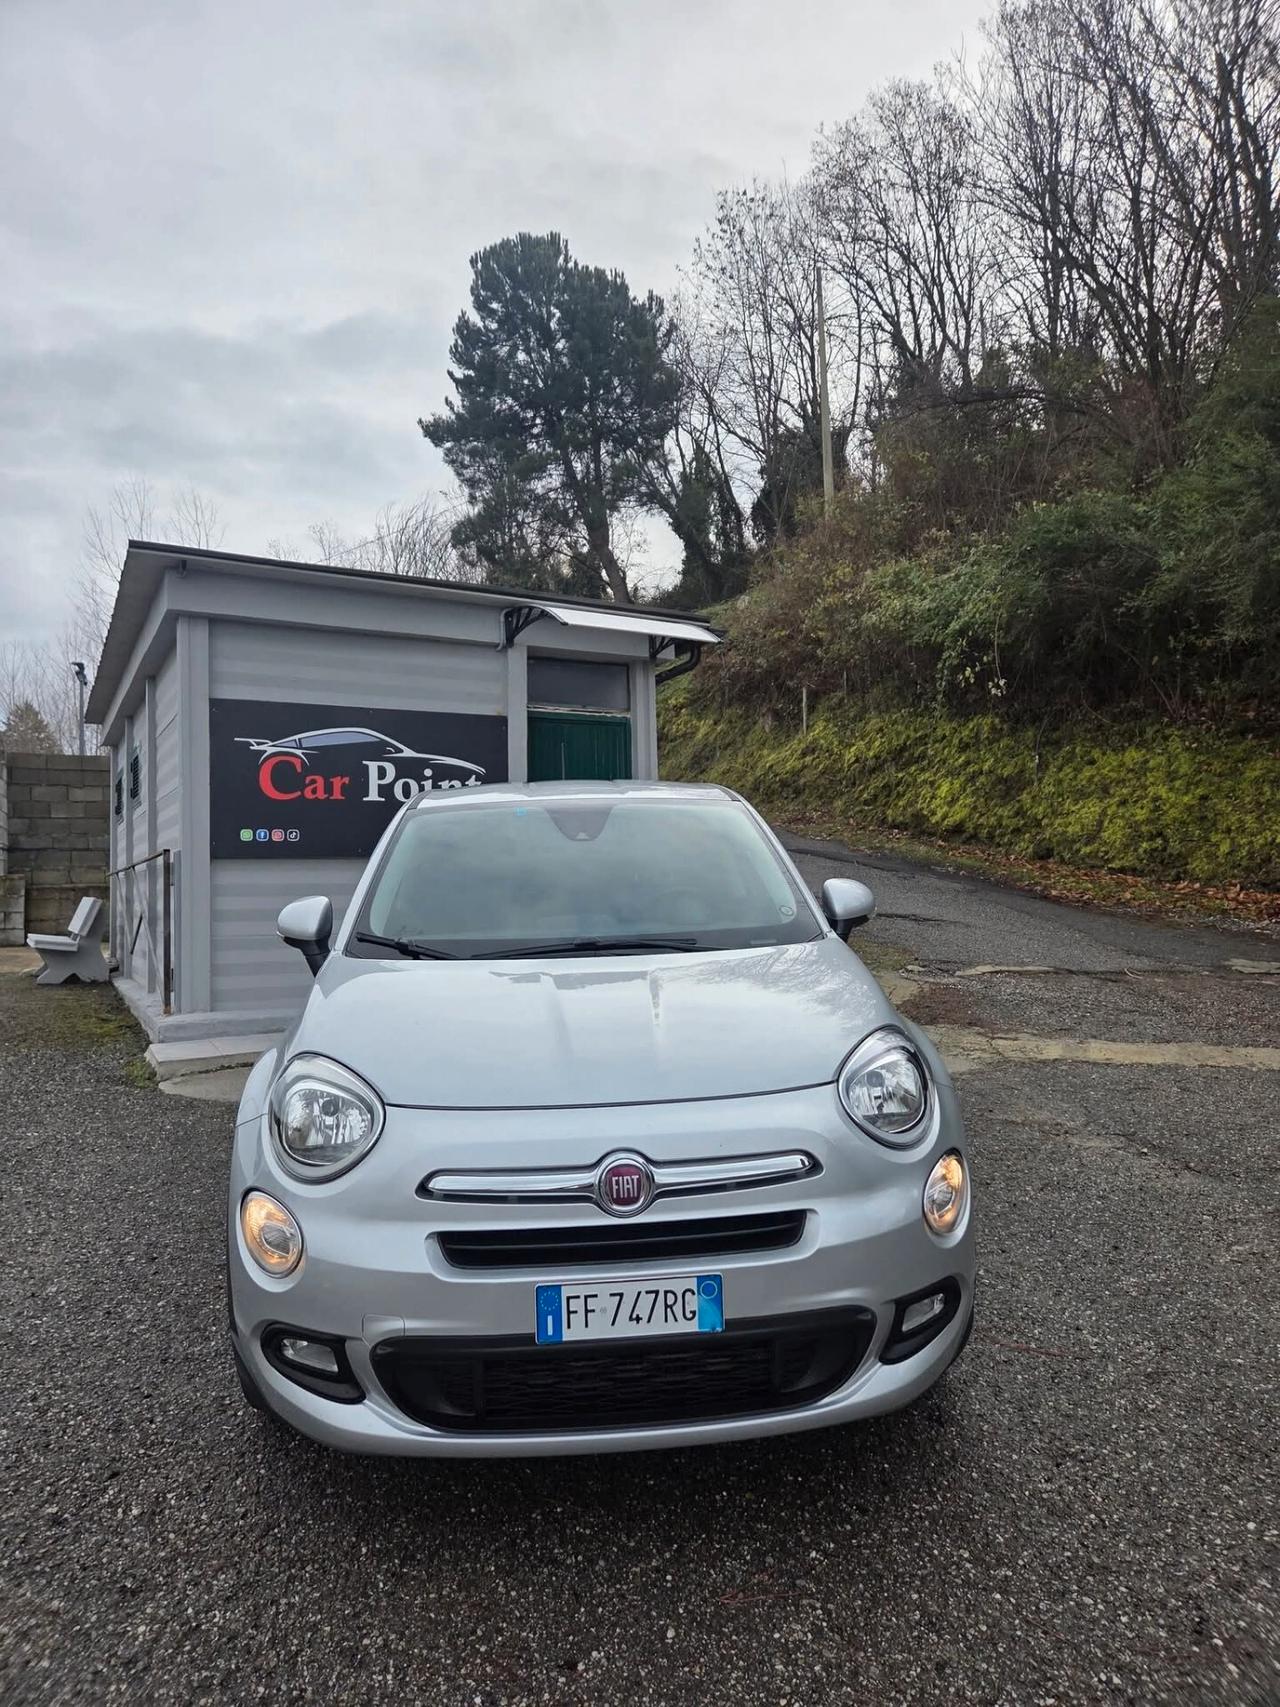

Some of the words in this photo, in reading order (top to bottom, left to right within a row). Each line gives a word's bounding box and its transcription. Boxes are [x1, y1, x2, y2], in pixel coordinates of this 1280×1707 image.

[258, 755, 349, 800] Car
[612, 1175, 639, 1199] FIAT
[566, 1294, 598, 1329] FF
[609, 1288, 696, 1327] 747RG
